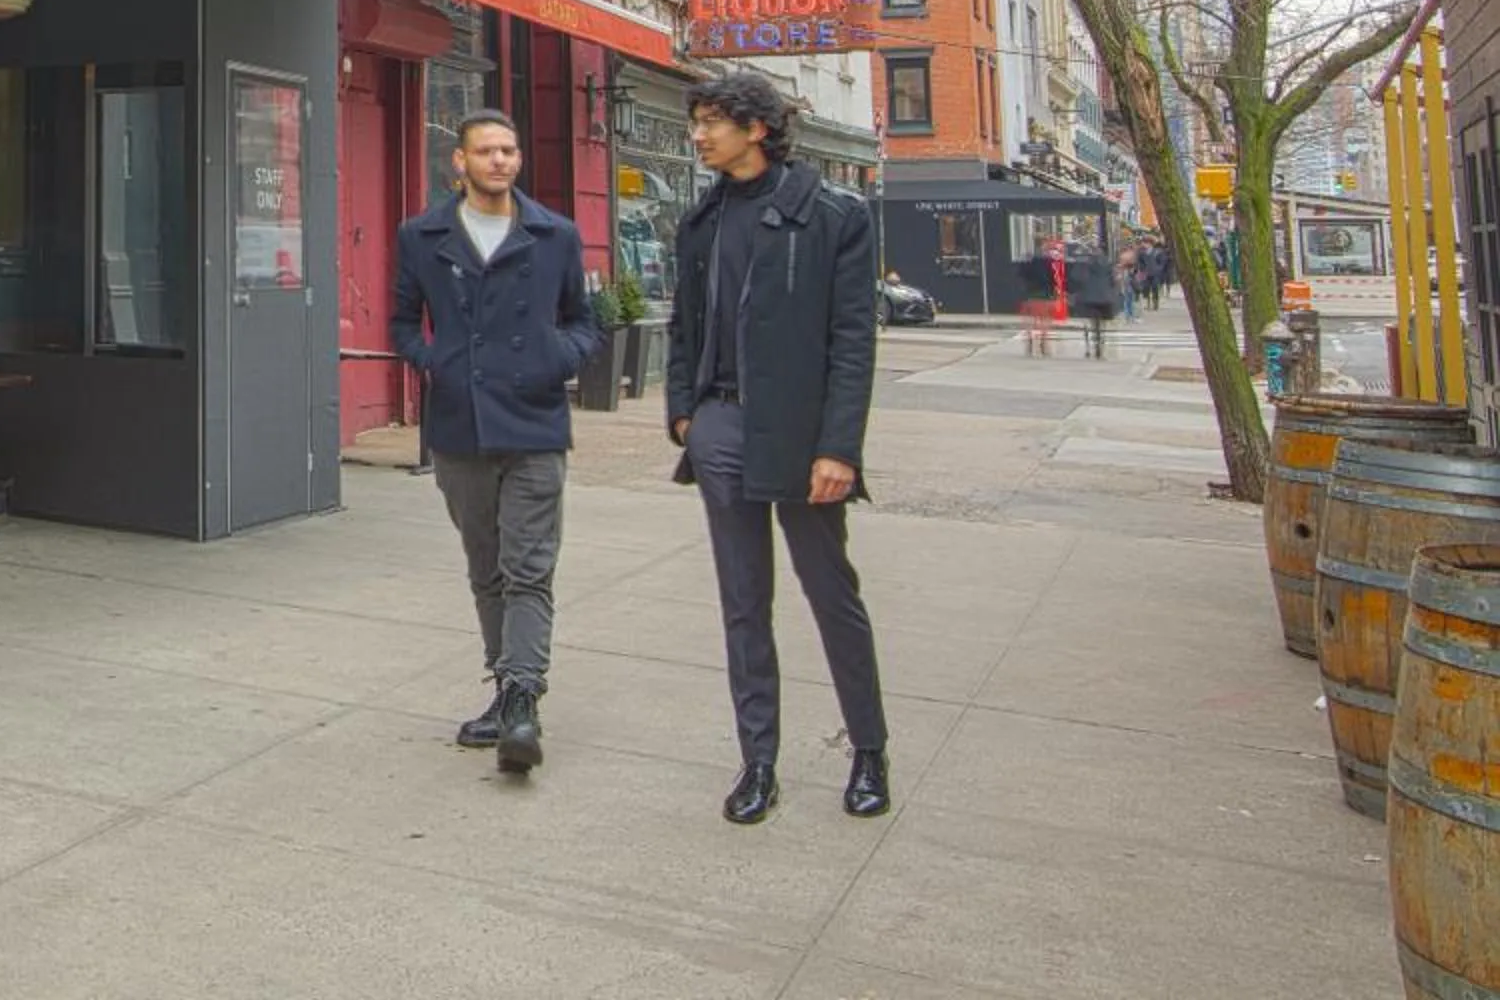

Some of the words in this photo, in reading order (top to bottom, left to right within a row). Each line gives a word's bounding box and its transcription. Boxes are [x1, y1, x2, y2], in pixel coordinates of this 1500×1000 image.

[708, 18, 838, 49] STORE
[254, 167, 285, 185] STAFF
[256, 190, 283, 210] ONLY
